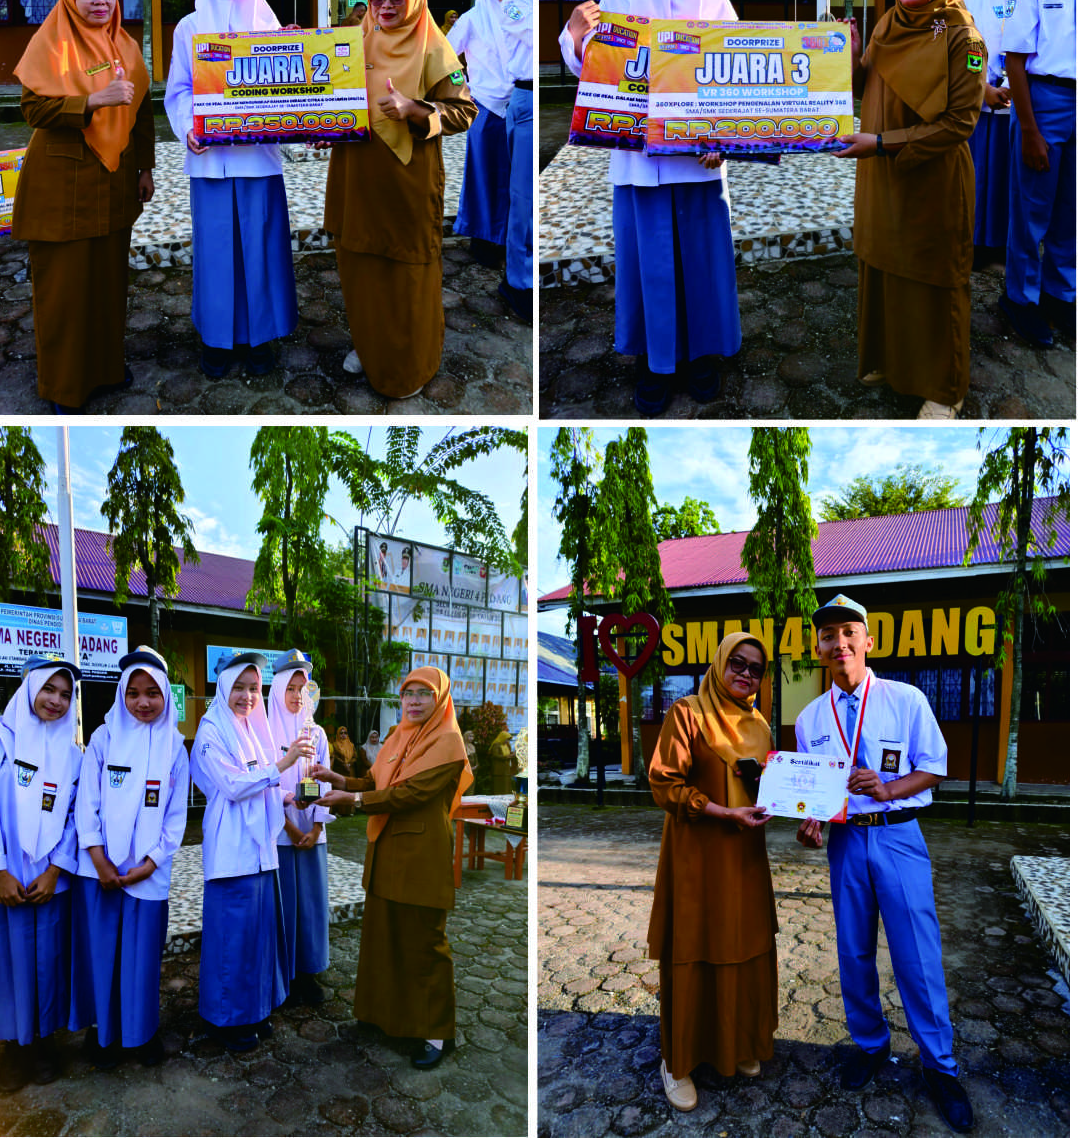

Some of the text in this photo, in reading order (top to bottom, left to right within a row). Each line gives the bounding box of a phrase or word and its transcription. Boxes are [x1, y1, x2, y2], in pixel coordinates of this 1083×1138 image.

[657, 31, 674, 43] UPI
[727, 38, 780, 47] DOORPRIZE
[253, 44, 300, 53] DOORPRIZE
[226, 53, 330, 87] JUARA 2
[695, 52, 811, 85] JUARA 3
[231, 86, 326, 97] CODING WORKSHOP
[702, 88, 804, 97] VR 360 WORKSHOP
[204, 111, 357, 134] RP.350.000
[663, 117, 839, 141] RP.200.000
[419, 582, 439, 596] SMA
[16, 629, 61, 649] NEGERI
